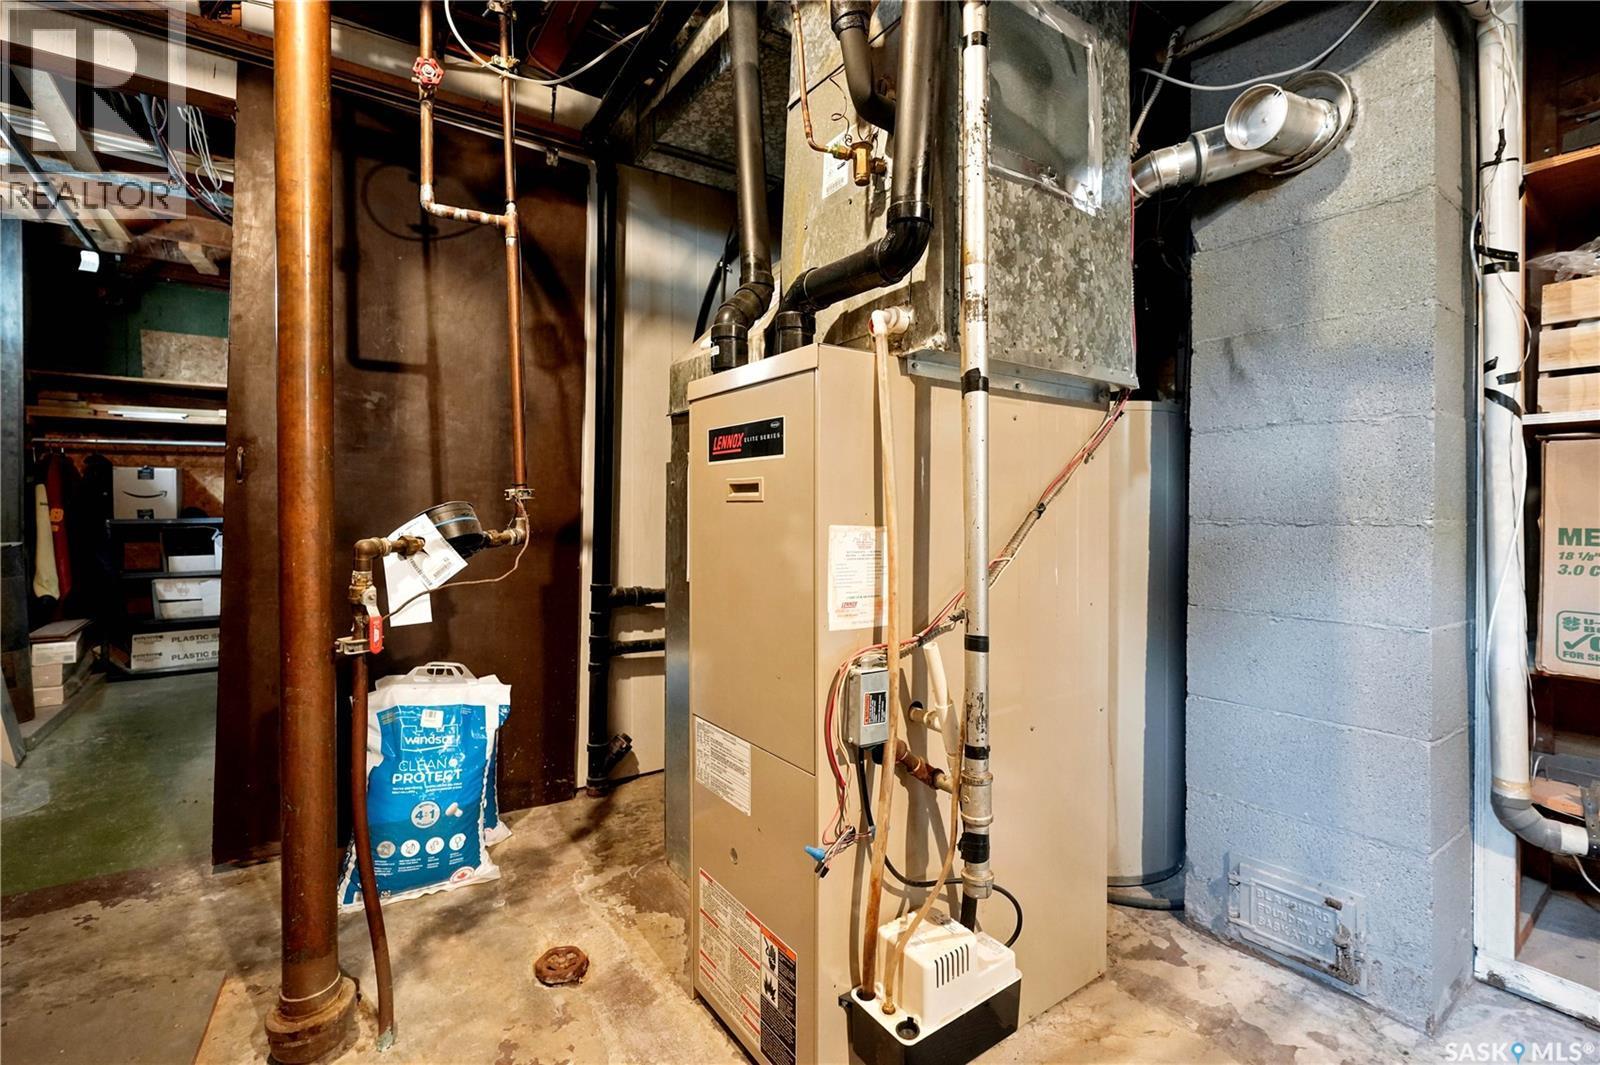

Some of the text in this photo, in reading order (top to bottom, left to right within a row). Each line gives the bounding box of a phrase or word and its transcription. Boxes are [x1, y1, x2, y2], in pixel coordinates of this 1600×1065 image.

[713, 432, 781, 451] LENNOX ELITE SERIES
[1558, 527, 1600, 546] ME
[1559, 551, 1575, 561] 18
[1557, 563, 1585, 576] 3.0
[171, 633, 209, 643] PLASTIC
[171, 650, 209, 661] PLASTIC
[1562, 650, 1585, 660] FOR
[415, 810, 424, 820] 4
